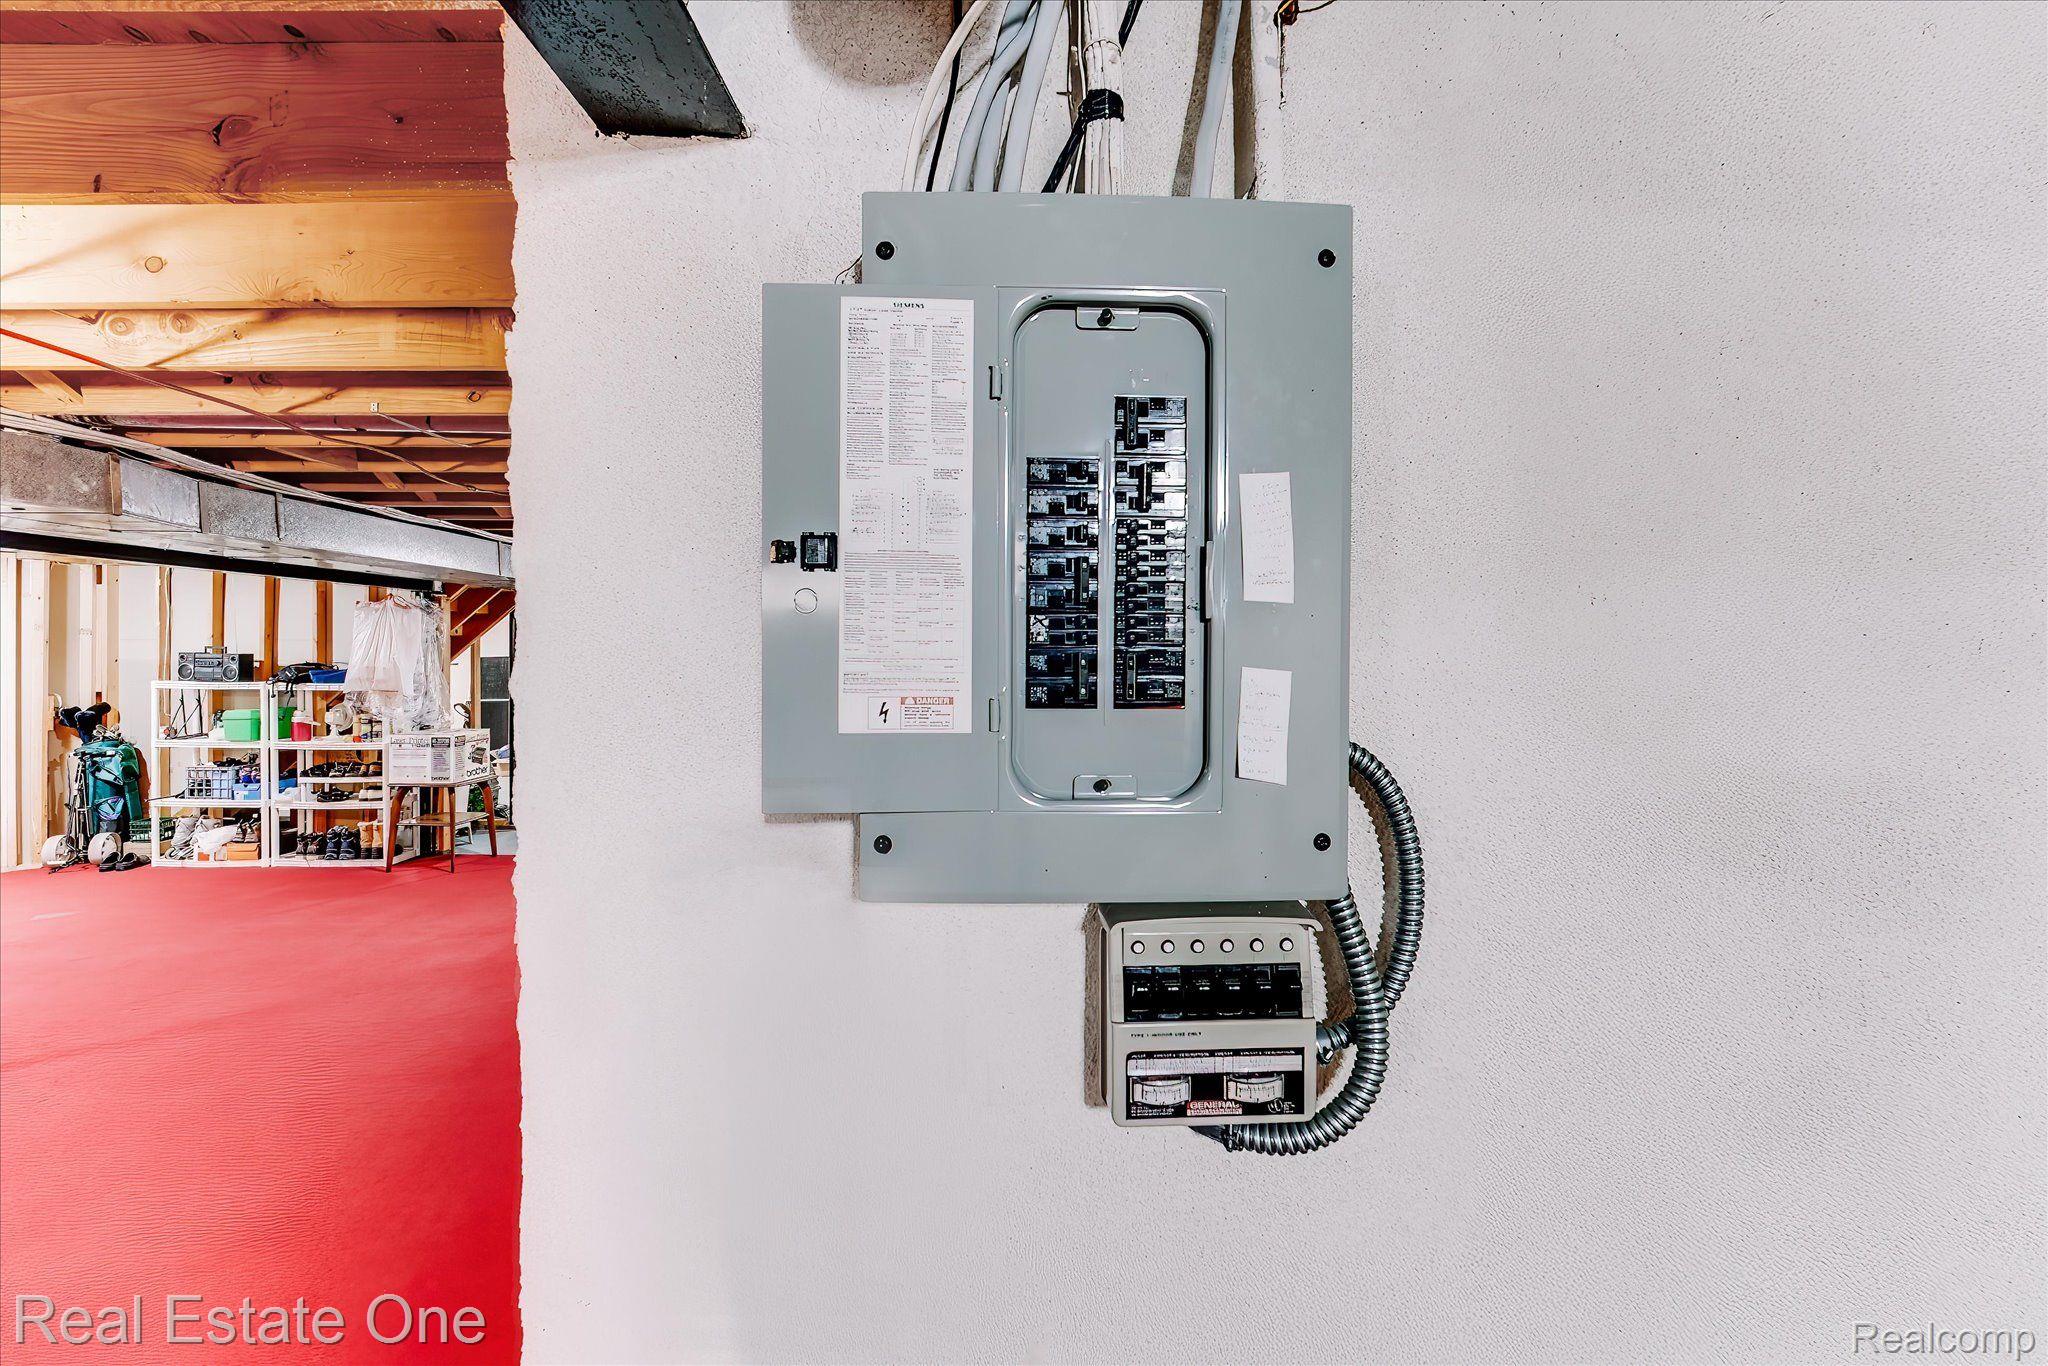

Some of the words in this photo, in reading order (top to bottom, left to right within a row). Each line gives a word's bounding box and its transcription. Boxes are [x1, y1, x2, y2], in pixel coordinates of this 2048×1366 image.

[916, 697, 950, 705] DANGER
[466, 766, 488, 777] brother
[1189, 1101, 1240, 1110] GENERAL
